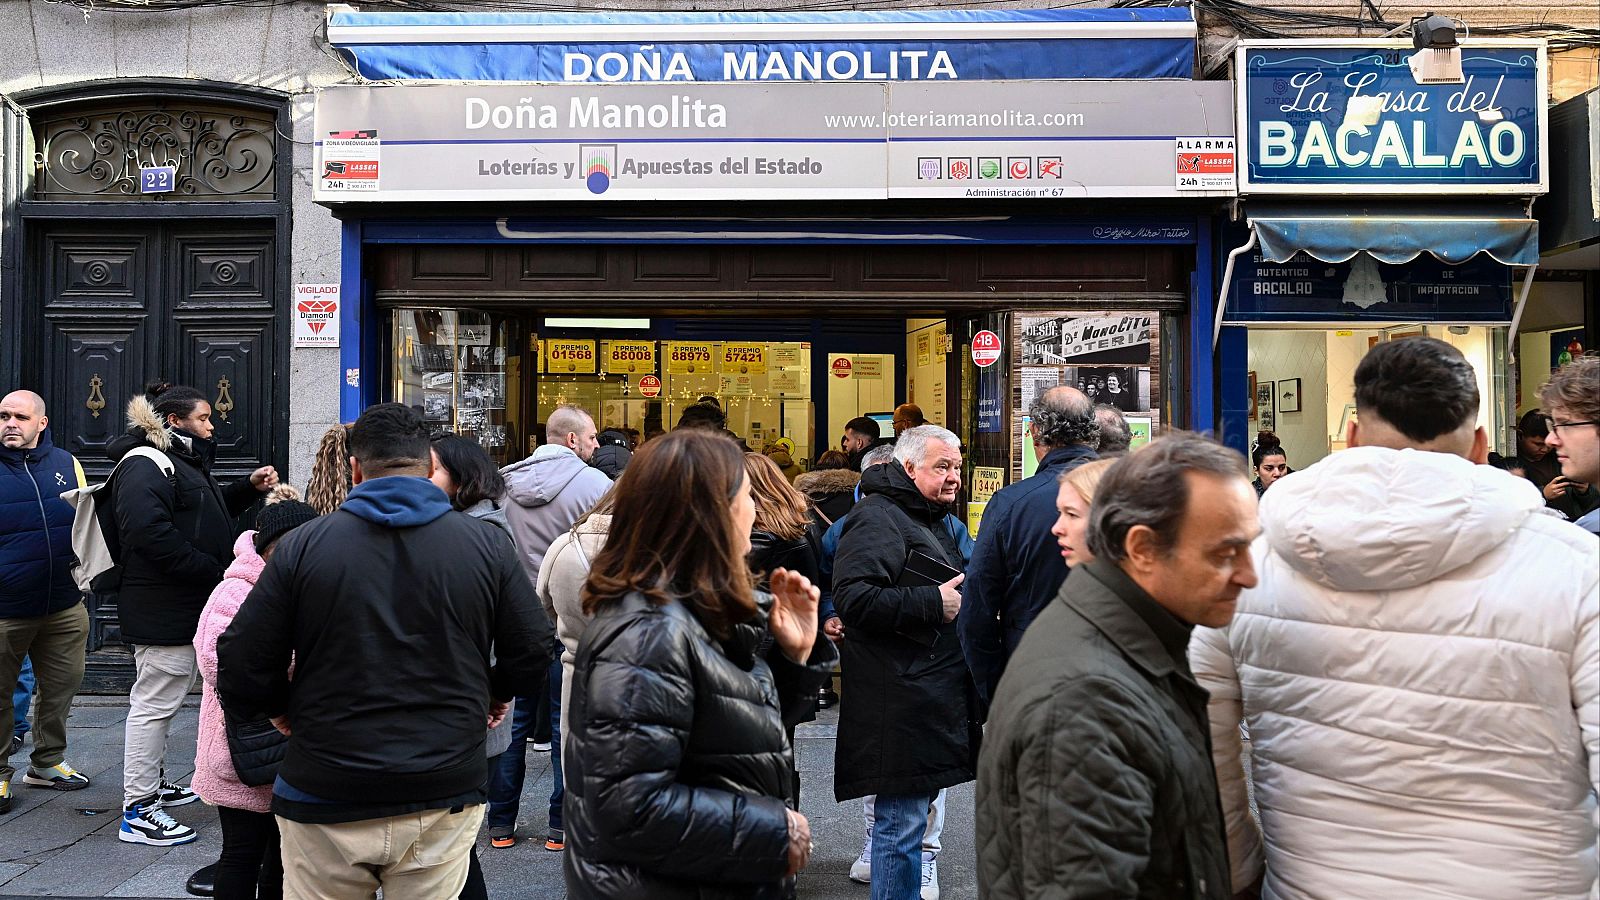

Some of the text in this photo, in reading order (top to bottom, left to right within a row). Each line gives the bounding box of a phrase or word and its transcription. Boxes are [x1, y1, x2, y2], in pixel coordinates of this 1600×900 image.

[564, 45, 958, 82] DOÑA MANOLITA
[1280, 72, 1332, 113] La
[1446, 75, 1506, 113] del
[466, 96, 727, 130] Doña Manolita
[824, 110, 1084, 128] www.loteriamanolita.com
[1177, 140, 1234, 149] ALARMA
[1259, 120, 1526, 168] BACALAO
[478, 157, 823, 180] Loterías y Apuestas del Estado
[146, 172, 168, 188] 22
[328, 180, 344, 188] 24h
[1180, 178, 1198, 186] 24h
[966, 188, 1036, 198] Administración
[1052, 188, 1064, 197] 67
[1257, 268, 1309, 277] AUTENTICO
[1254, 282, 1312, 295] BACALAO
[1418, 286, 1479, 295] IMPORTACION
[1026, 325, 1058, 336] DESDE
[976, 335, 993, 346] +18
[1064, 329, 1150, 356] LOTERIA
[1031, 344, 1053, 354] 1904
[552, 351, 592, 360] 01568
[612, 351, 651, 360] 88008
[672, 352, 710, 361] 88979
[725, 353, 762, 362] 57421
[981, 471, 997, 479] PREMIO
[974, 480, 1000, 492] 13440
